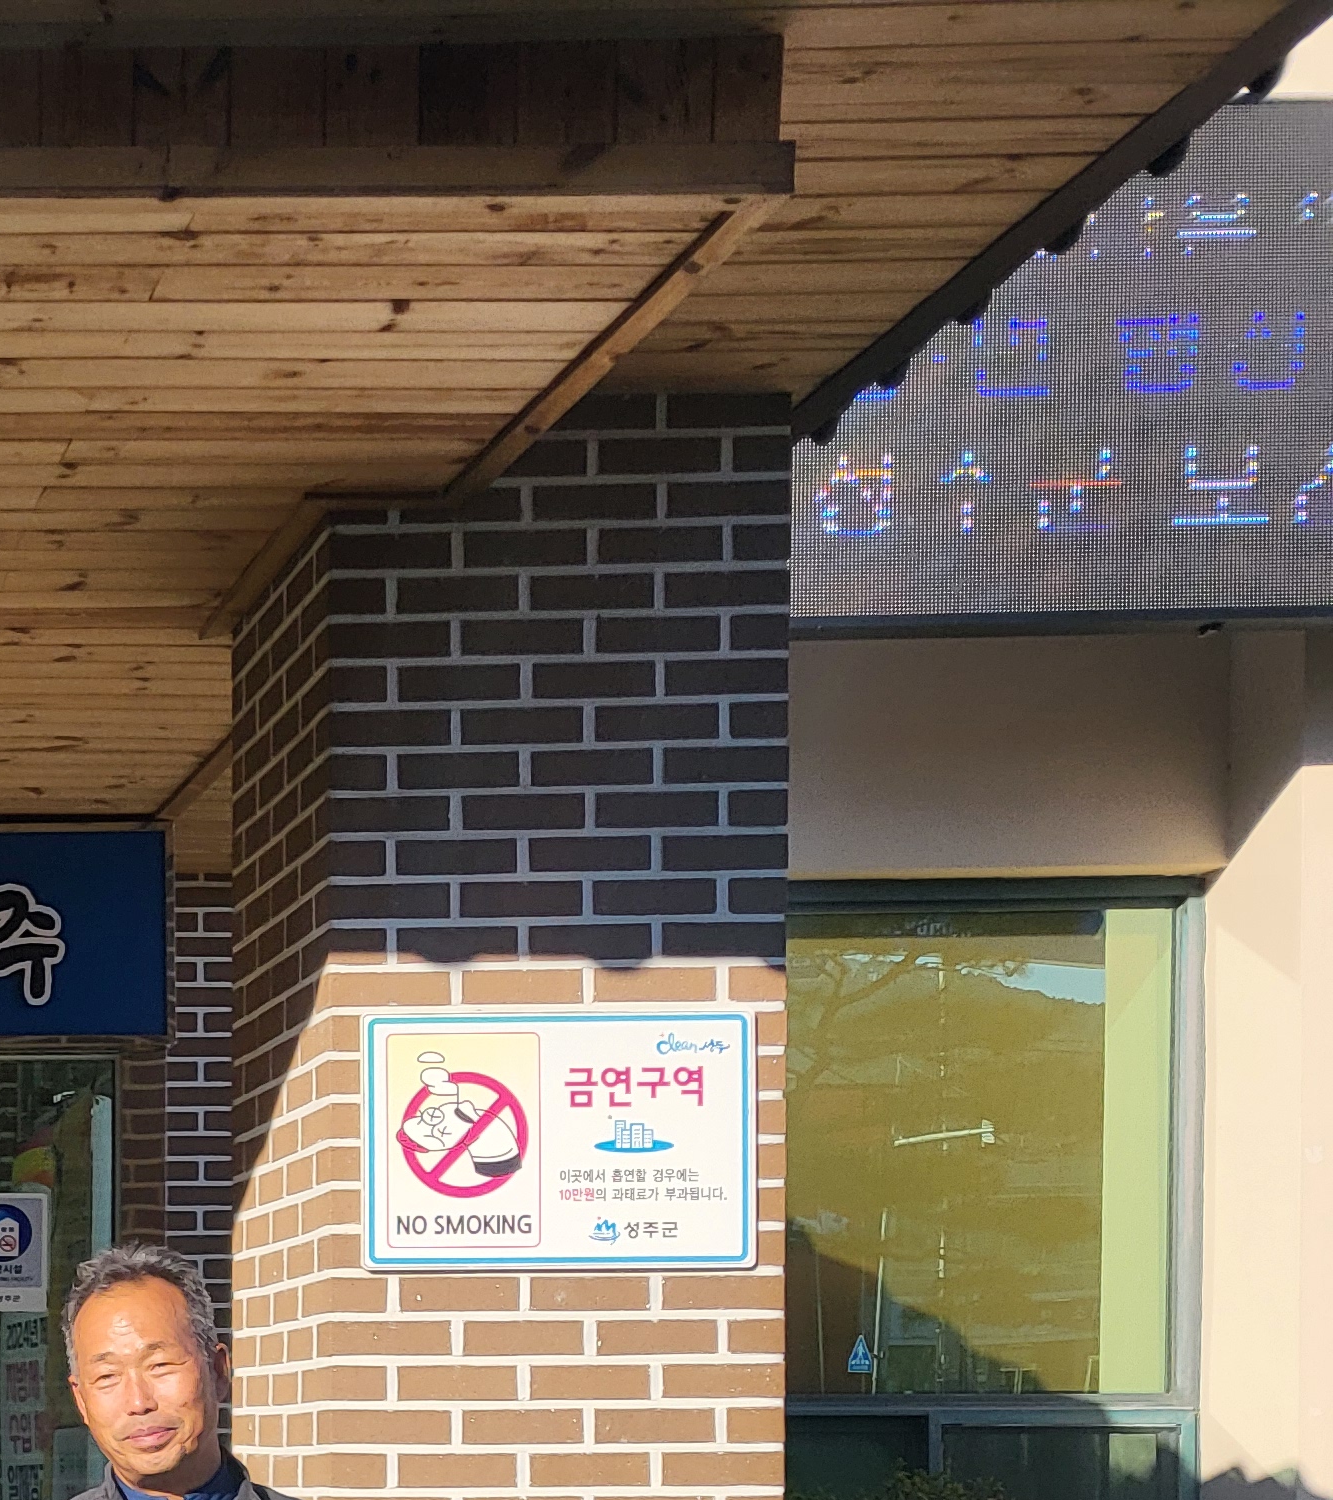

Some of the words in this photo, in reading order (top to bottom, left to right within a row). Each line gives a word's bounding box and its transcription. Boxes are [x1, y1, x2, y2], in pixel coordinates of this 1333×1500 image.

[564, 1065, 704, 1108] 금연구역
[559, 1169, 606, 1183] 이곳에서
[611, 1168, 646, 1183] 흡연할
[652, 1168, 699, 1183] 경우에는
[559, 1187, 607, 1201] 10만원의
[612, 1187, 660, 1202] 과태료가
[665, 1187, 728, 1201] 부과됩니다.
[396, 1215, 427, 1236] NO
[434, 1214, 532, 1235] SMOKING
[623, 1220, 679, 1239] 성주군
